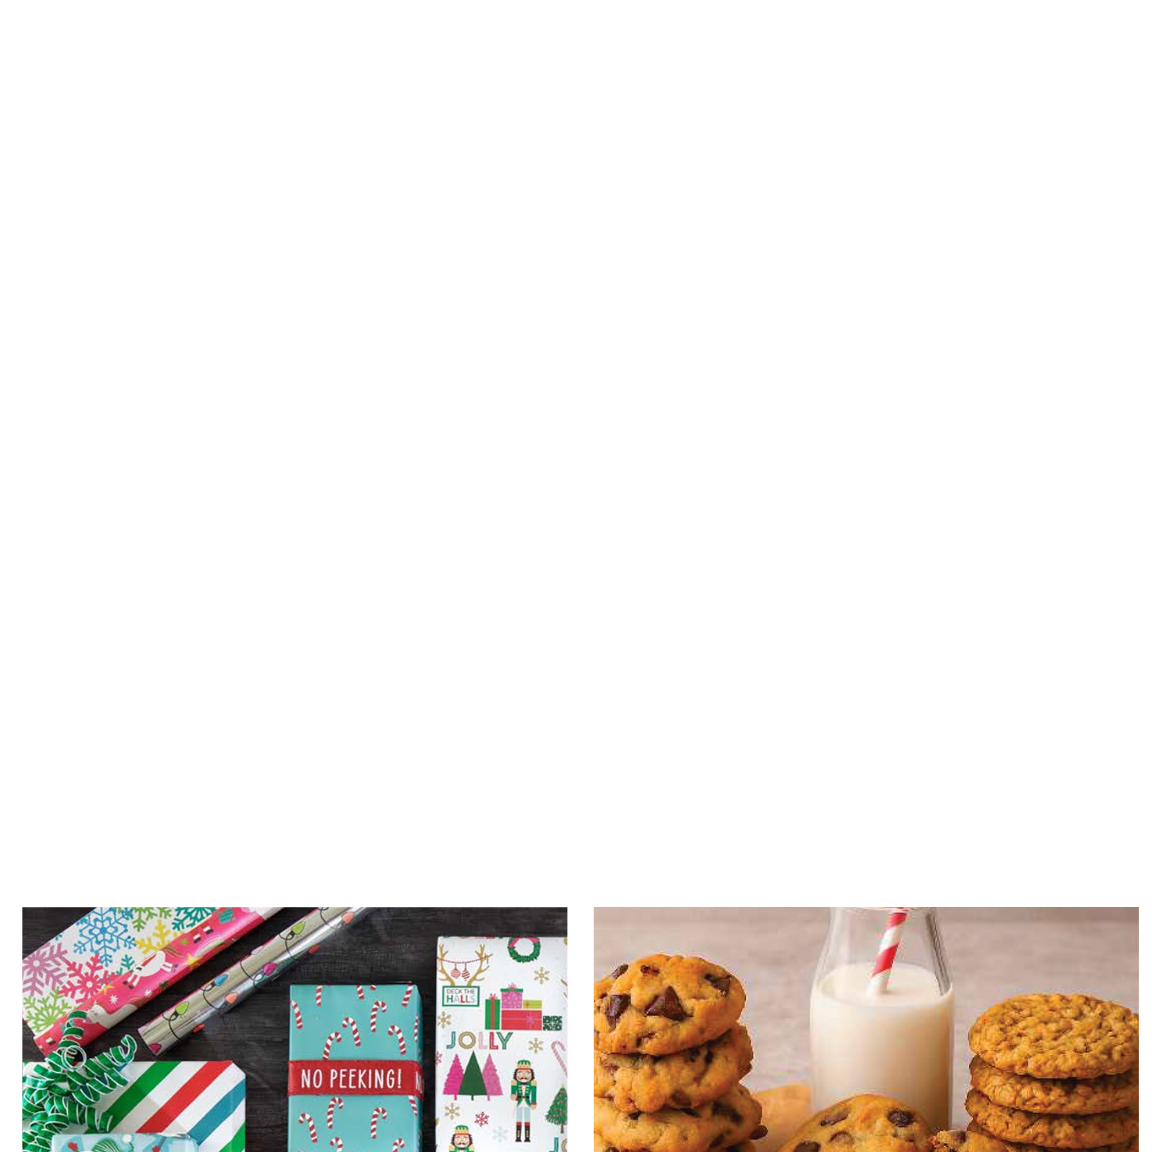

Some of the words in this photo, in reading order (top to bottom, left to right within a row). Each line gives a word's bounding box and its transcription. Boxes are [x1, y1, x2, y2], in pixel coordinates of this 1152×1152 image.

[446, 995, 476, 1003] HALLS
[446, 1031, 514, 1050] JOLLY
[301, 1069, 322, 1089] NO
[330, 1068, 402, 1090] PEEKING!
